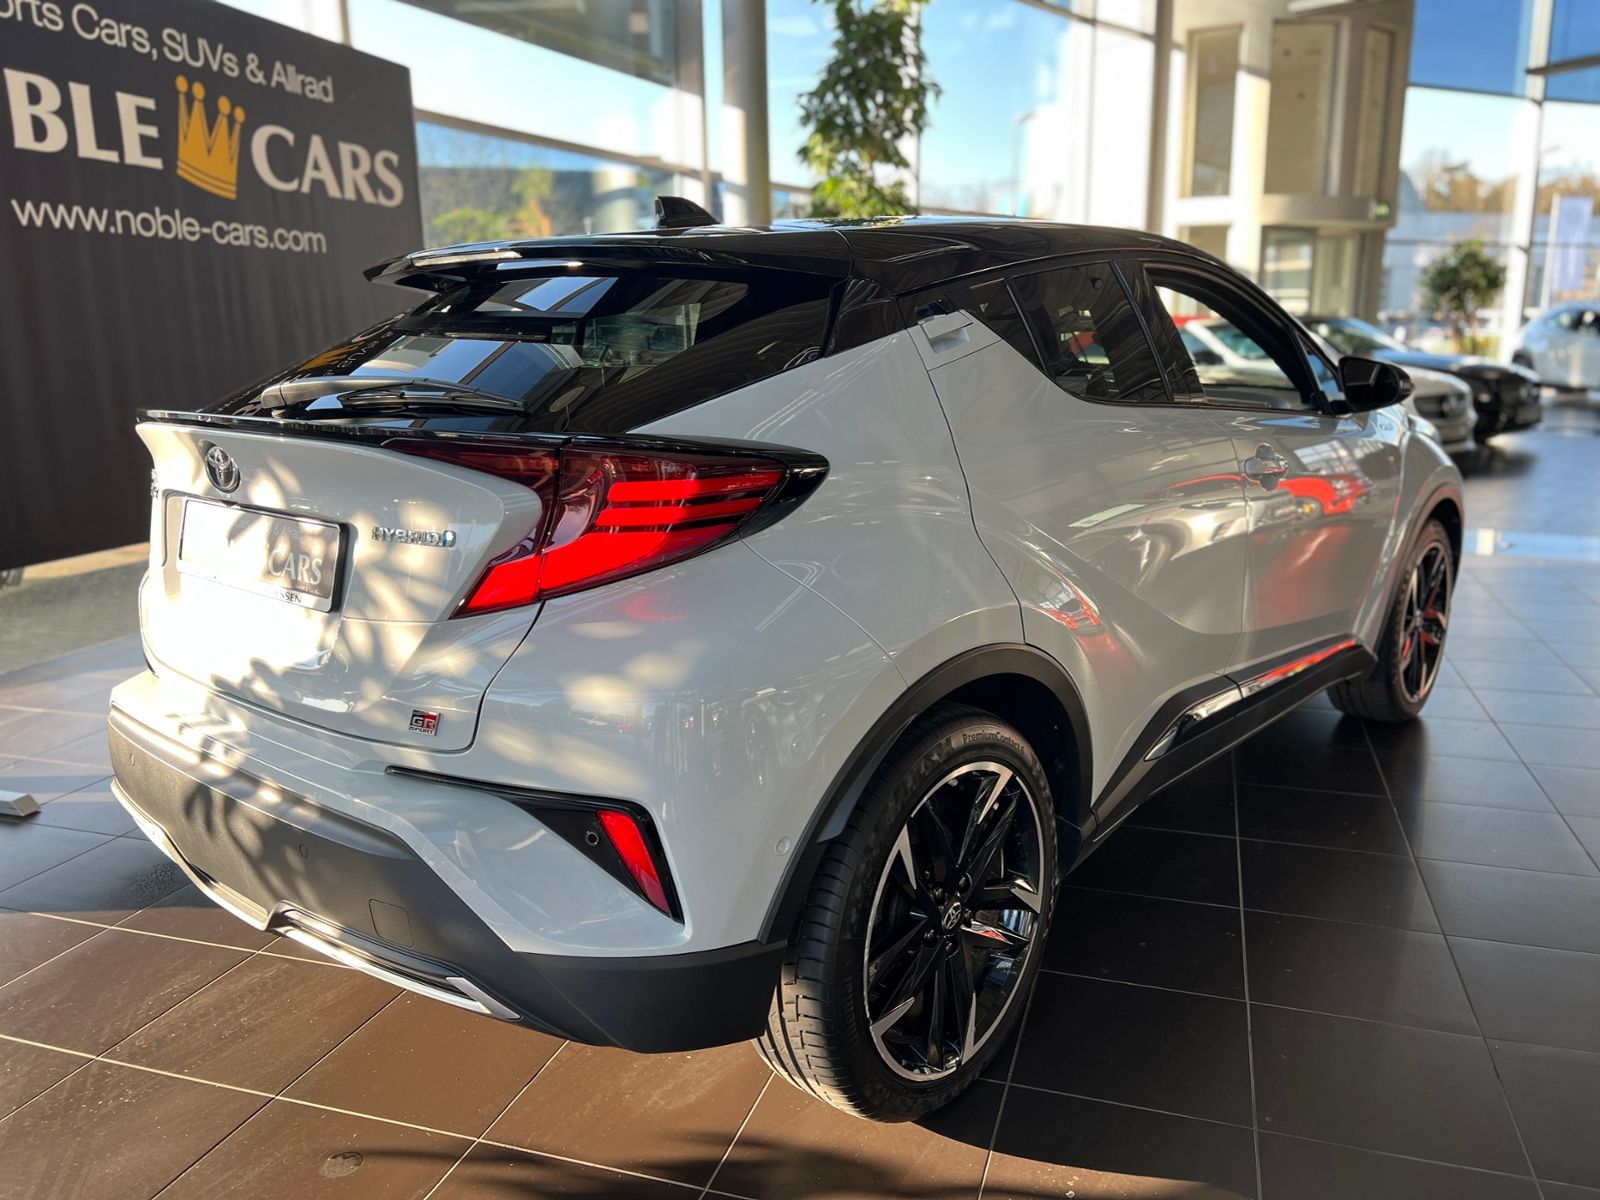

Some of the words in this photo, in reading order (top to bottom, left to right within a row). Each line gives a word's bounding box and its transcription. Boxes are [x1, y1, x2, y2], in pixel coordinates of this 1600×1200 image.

[71, 3, 158, 60] Cars,
[161, 28, 239, 78] SUVs
[245, 52, 267, 86] &
[271, 60, 335, 103] Allrad
[3, 67, 163, 170] BLE
[250, 123, 404, 209] CARS
[11, 199, 327, 255] www.noble-cars.com
[372, 525, 440, 547] HYBRID
[268, 548, 322, 585] CARS
[411, 716, 436, 729] GR
